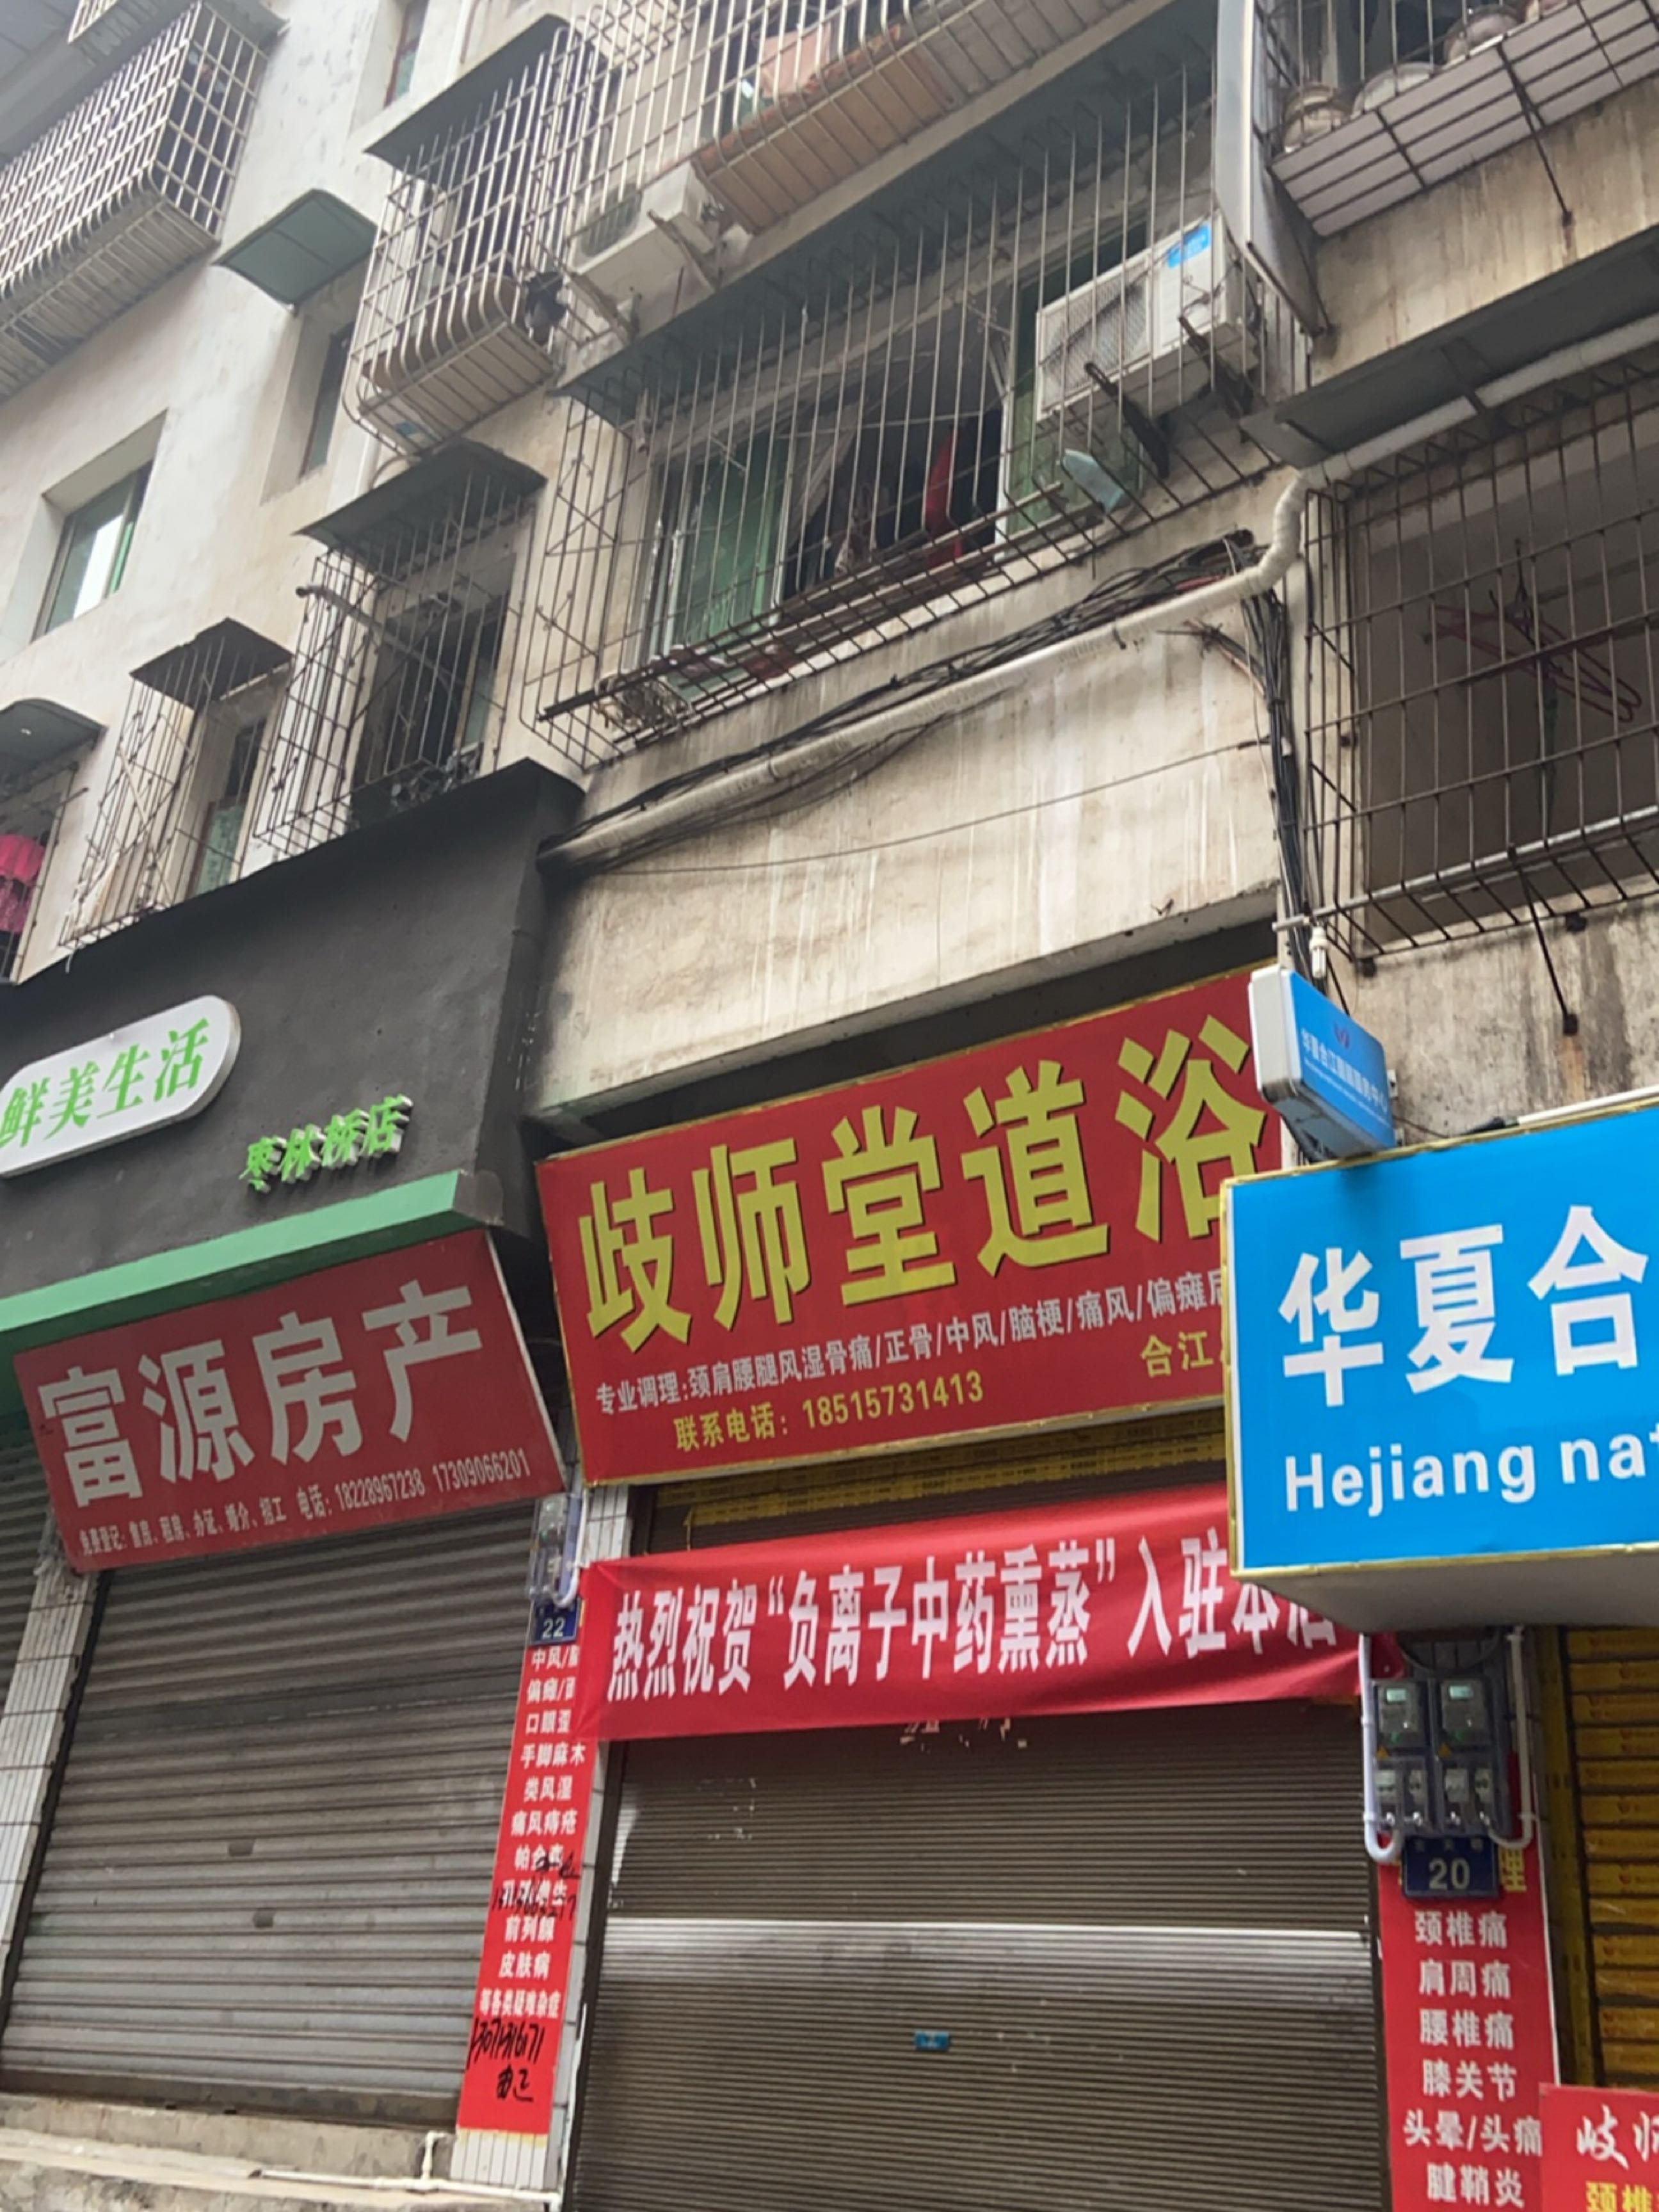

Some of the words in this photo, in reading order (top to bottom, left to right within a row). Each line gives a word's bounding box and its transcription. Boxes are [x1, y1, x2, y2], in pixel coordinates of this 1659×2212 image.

[0, 1017, 209, 1147] 鲜美生活
[1278, 1205, 1649, 1407] 华夏合
[1141, 1331, 1223, 1377] 合江
[37, 1280, 483, 1508] 富源房产
[433, 1448, 531, 1492] 17309066201
[1285, 1443, 1536, 1516] Hejiang
[542, 1617, 566, 1639] 22
[520, 1741, 586, 1770] 手脚麻木
[524, 1775, 573, 1802] 类风湿
[1428, 1857, 1471, 1889] 20
[1414, 1909, 1507, 1949] 颈椎痛
[498, 1950, 551, 1980] 皮肤病
[1418, 1958, 1511, 2000] 肩周痛
[1420, 2008, 1514, 2051] 腰椎痛
[1422, 2058, 1517, 2102] 膝关节
[1402, 2108, 1543, 2157] 头晕/头痛
[1427, 2161, 1525, 2209] 腱鞘炎
[1585, 2180, 1659, 2212] 颈椎
